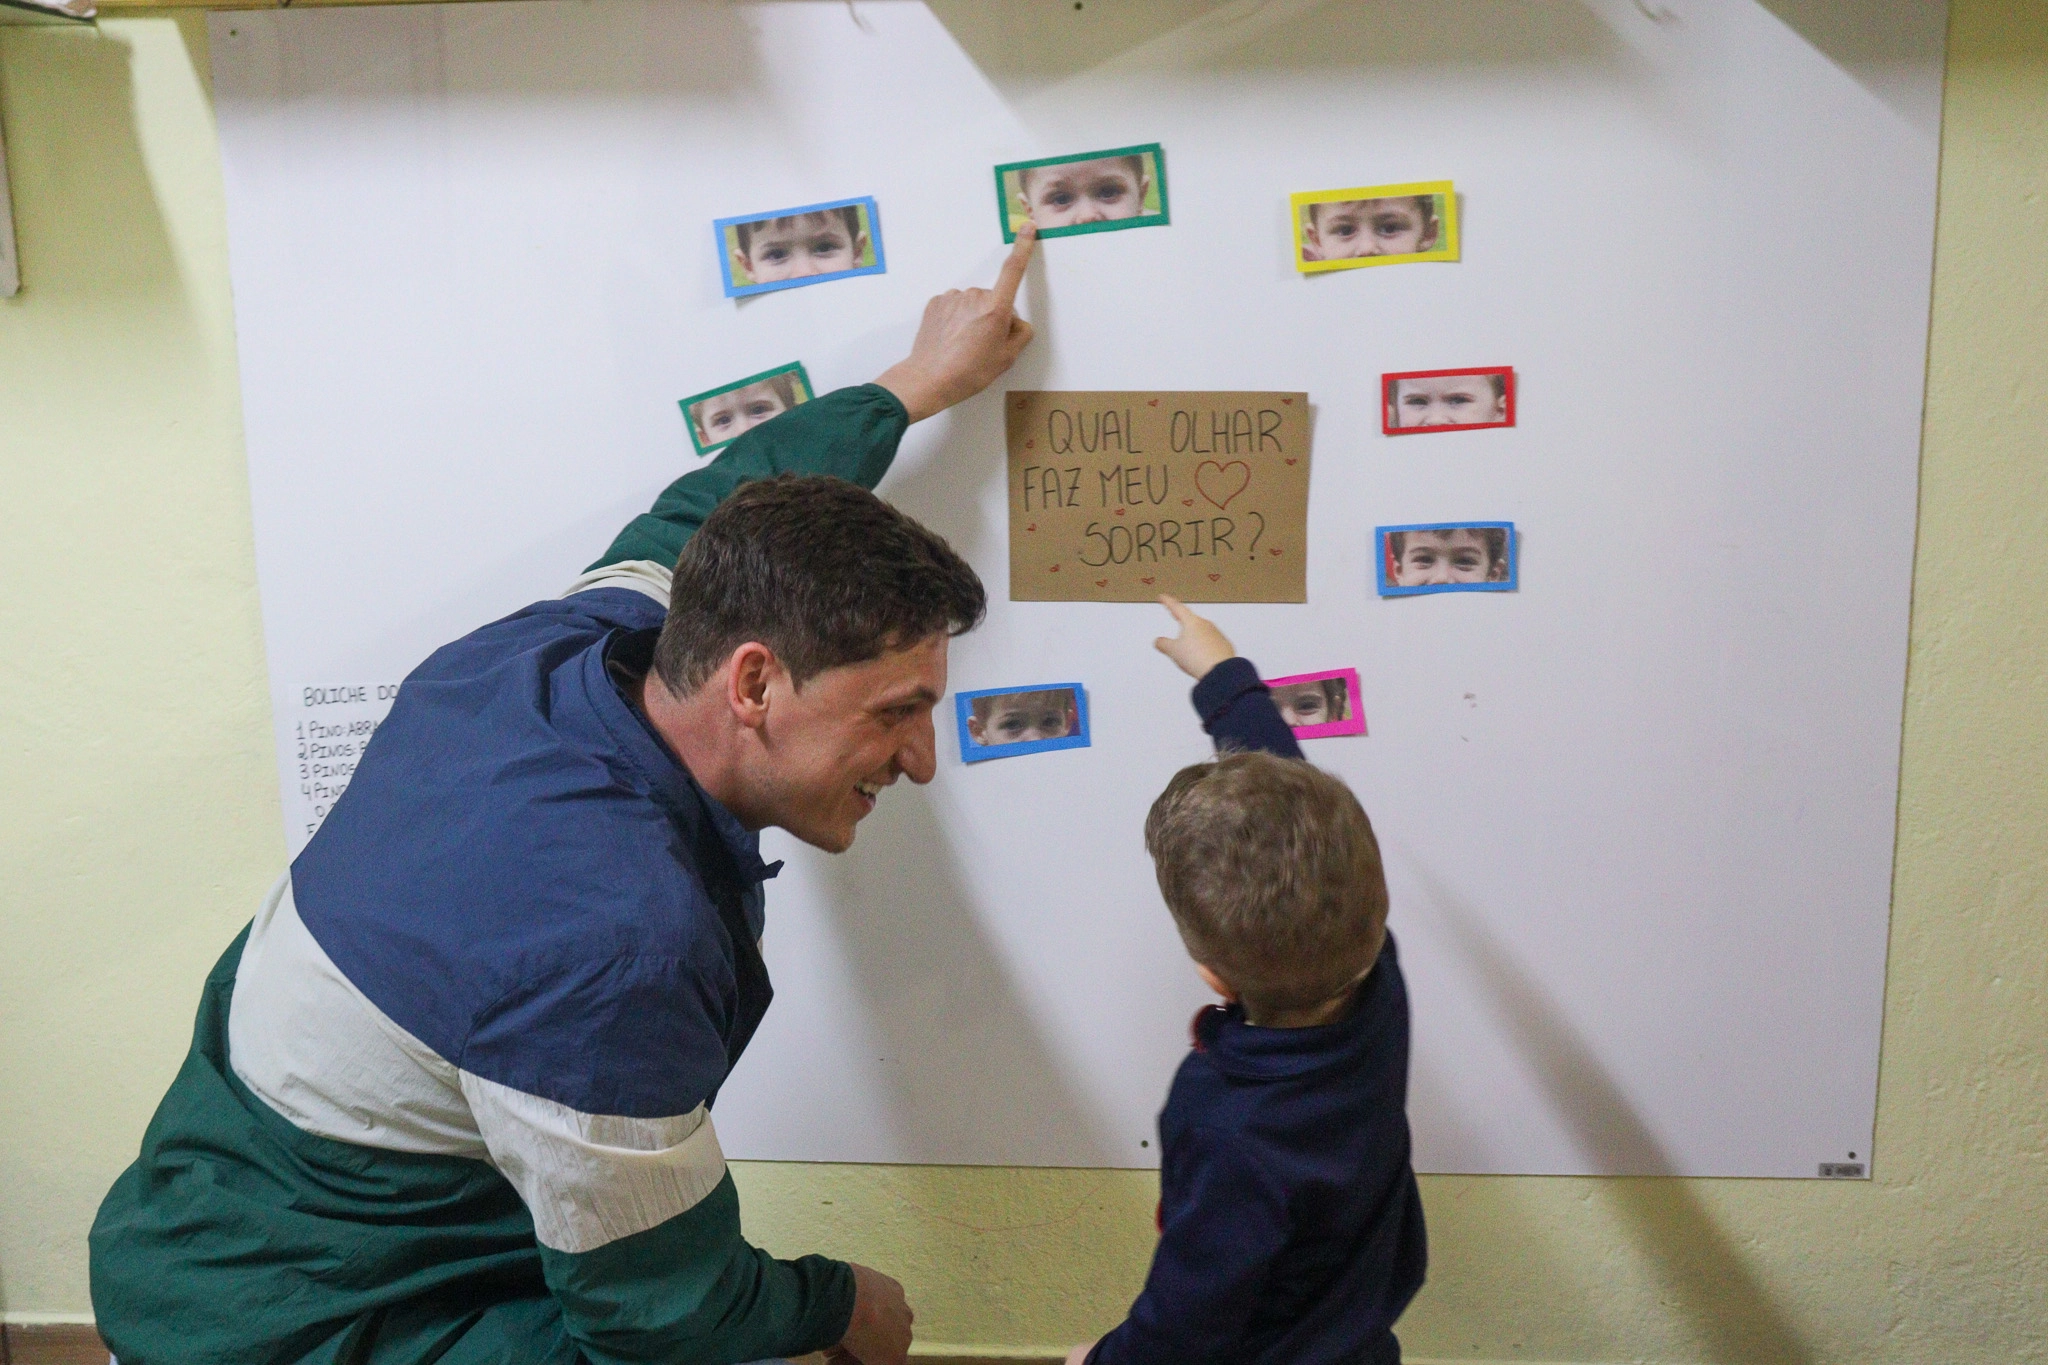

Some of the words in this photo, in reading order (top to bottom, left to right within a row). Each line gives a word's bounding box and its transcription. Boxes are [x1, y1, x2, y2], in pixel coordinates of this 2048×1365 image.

[1049, 409, 1142, 454] QUAL
[1171, 410, 1283, 454] OLHAR
[1024, 466, 1081, 512] FAZ
[1099, 465, 1168, 507] MEU
[302, 686, 367, 707] BOLICHE
[296, 721, 305, 739] 1
[297, 742, 308, 760] 2
[299, 763, 310, 779] 3
